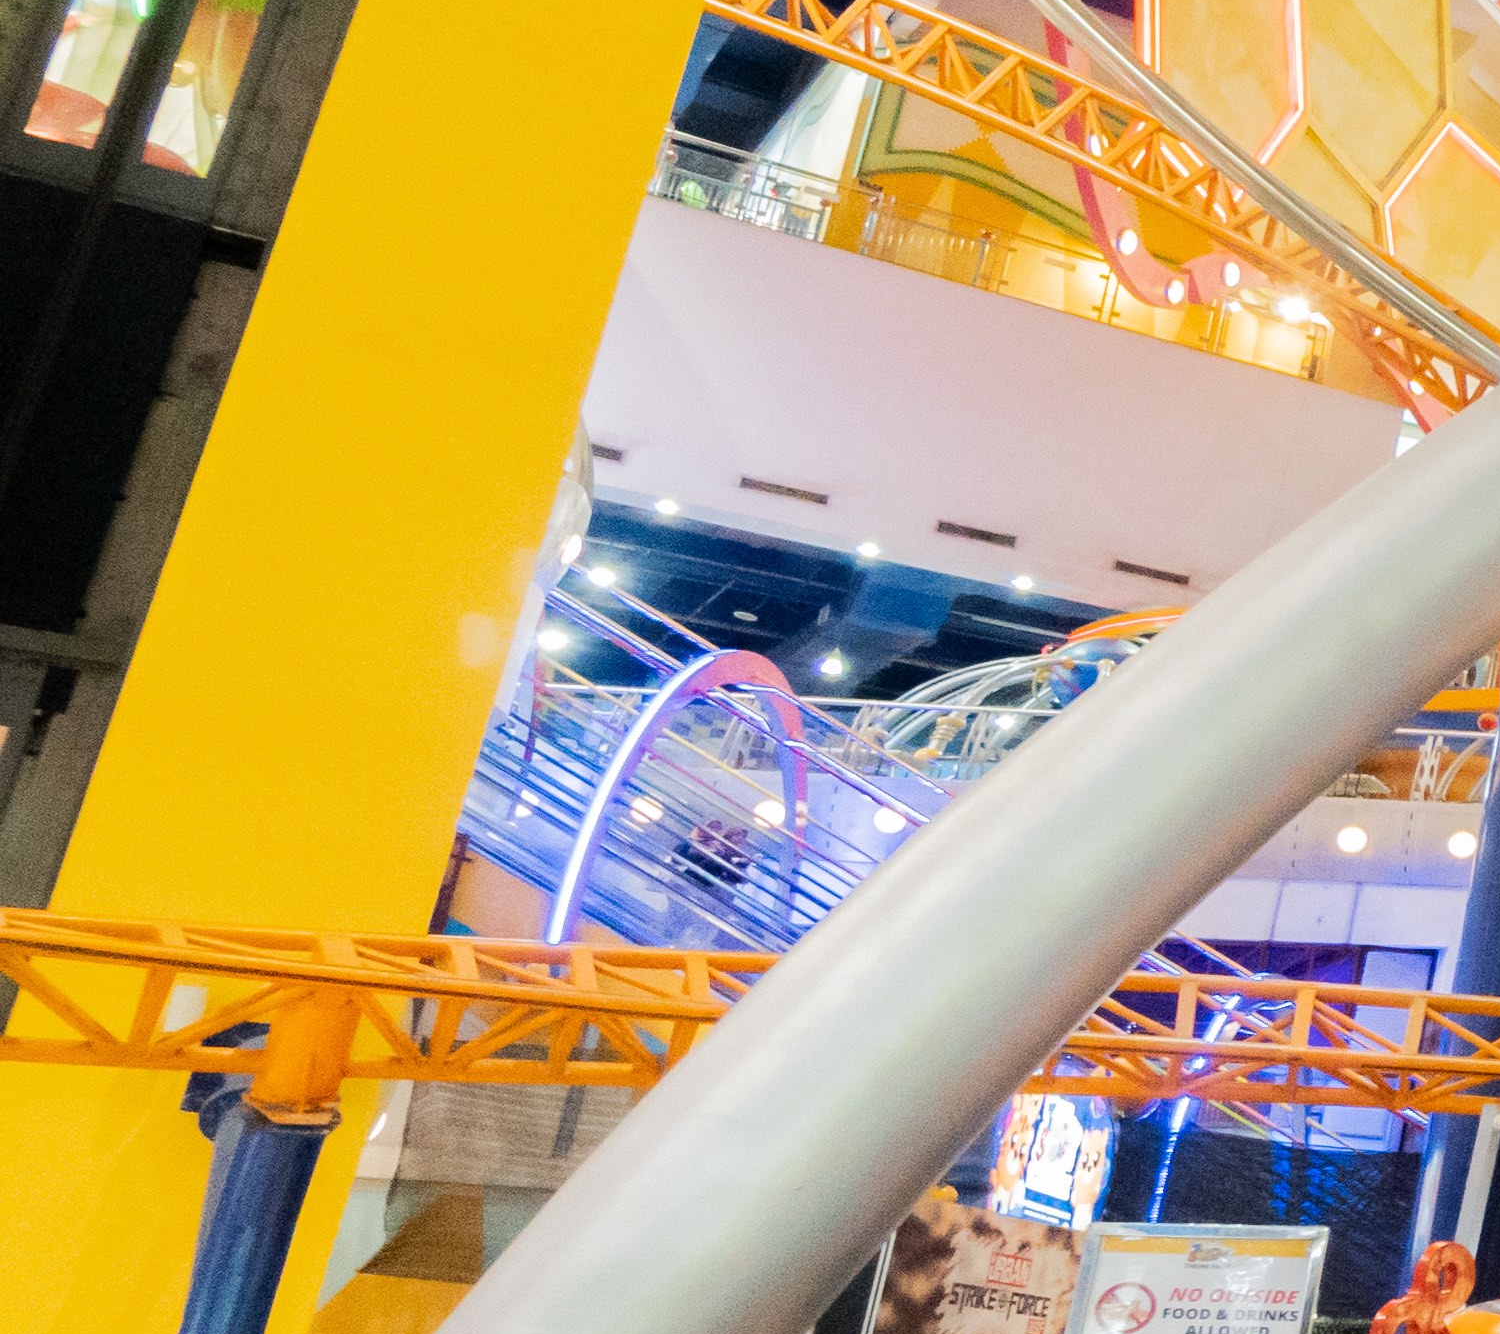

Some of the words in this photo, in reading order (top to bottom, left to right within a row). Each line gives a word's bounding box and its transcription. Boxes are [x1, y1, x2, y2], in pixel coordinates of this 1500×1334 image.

[948, 1282, 999, 1314] STRIKE
[1006, 1292, 1051, 1321] FORCE
[1168, 1286, 1203, 1303] NO
[1162, 1308, 1211, 1321] FOOD
[1216, 1309, 1228, 1320] &
[1235, 1309, 1299, 1323] DRINKS
